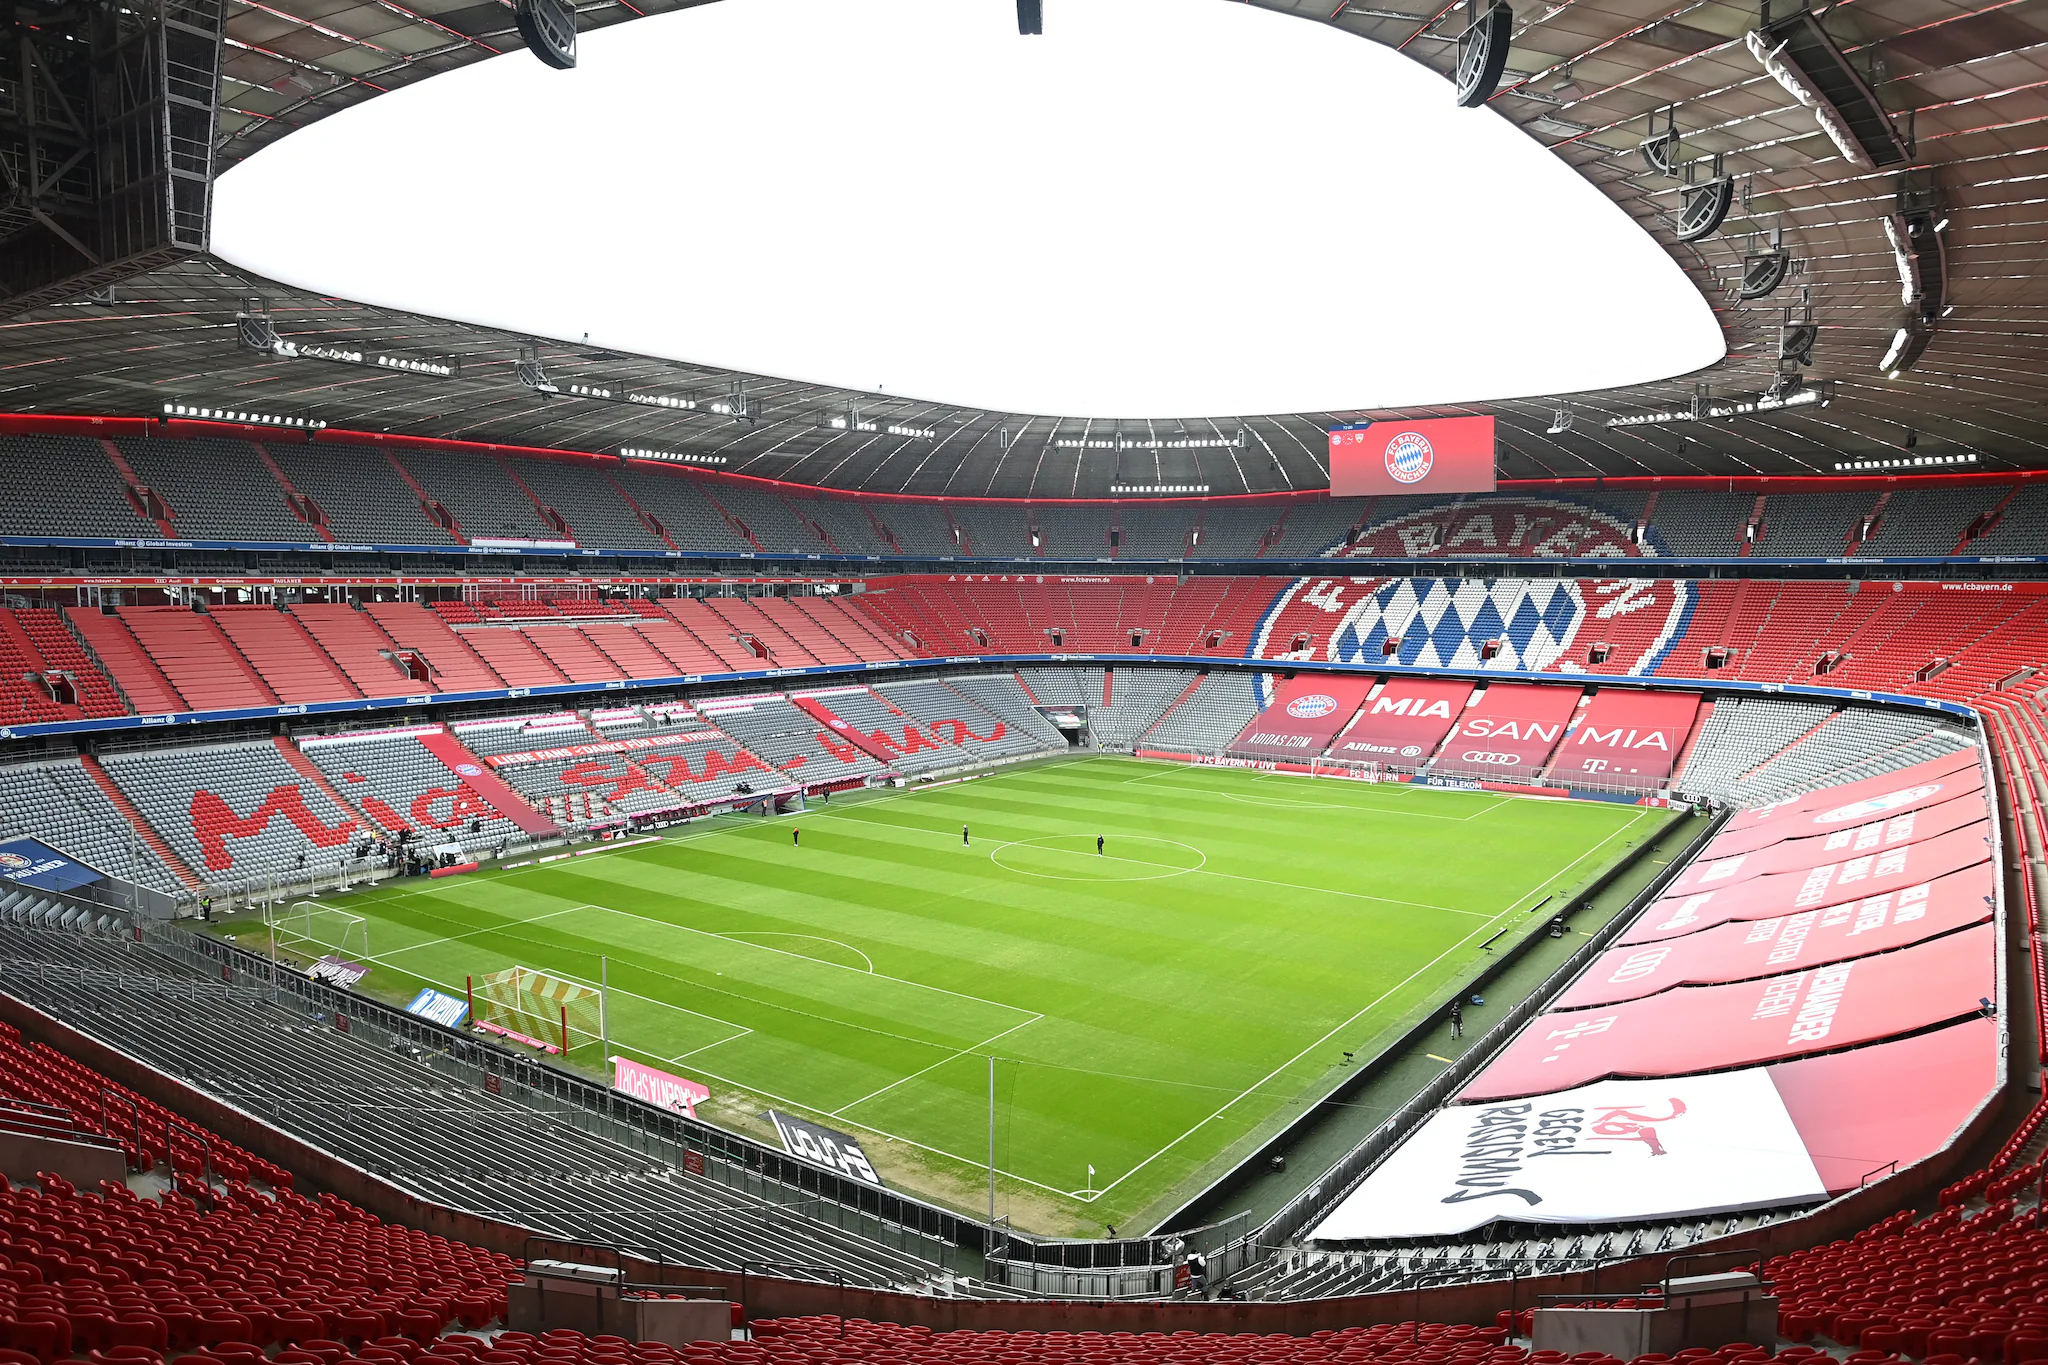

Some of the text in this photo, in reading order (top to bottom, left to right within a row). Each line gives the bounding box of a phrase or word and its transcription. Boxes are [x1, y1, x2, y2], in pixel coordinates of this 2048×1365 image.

[1388, 435, 1430, 456] FC BAYERN
[1388, 461, 1430, 481] MÜNCHEN
[165, 540, 193, 548] Investors
[1061, 576, 1110, 584] www.fcbayern.de
[1942, 582, 2013, 592] www.fcbayern.de
[1370, 697, 1450, 718] MIA
[1248, 733, 1312, 748] ADIDAS.COM
[1462, 719, 1559, 743] SAN
[1578, 727, 1668, 751] MIA
[493, 730, 725, 765] LIEBE FANS DANKE FÜR EURE TREUE!
[1343, 742, 1397, 755] Allianz
[1203, 756, 1276, 770] FC BAYERN.TV LIVE
[1350, 770, 1399, 782] FC BAYERN
[1427, 777, 1443, 786] FÜR
[1445, 779, 1482, 789] TELEKOM
[640, 823, 655, 832] Audi
[4, 859, 68, 879] PAULANER
[1743, 917, 1785, 945] EITEN
[419, 993, 469, 1027] Allianz
[617, 1065, 648, 1101] SPORT
[1527, 1107, 1613, 1158] GEGEN
[1585, 1097, 1688, 1158] ROT
[781, 1122, 879, 1183] e-tron
[1440, 1102, 1543, 1206] RASSISMUS
